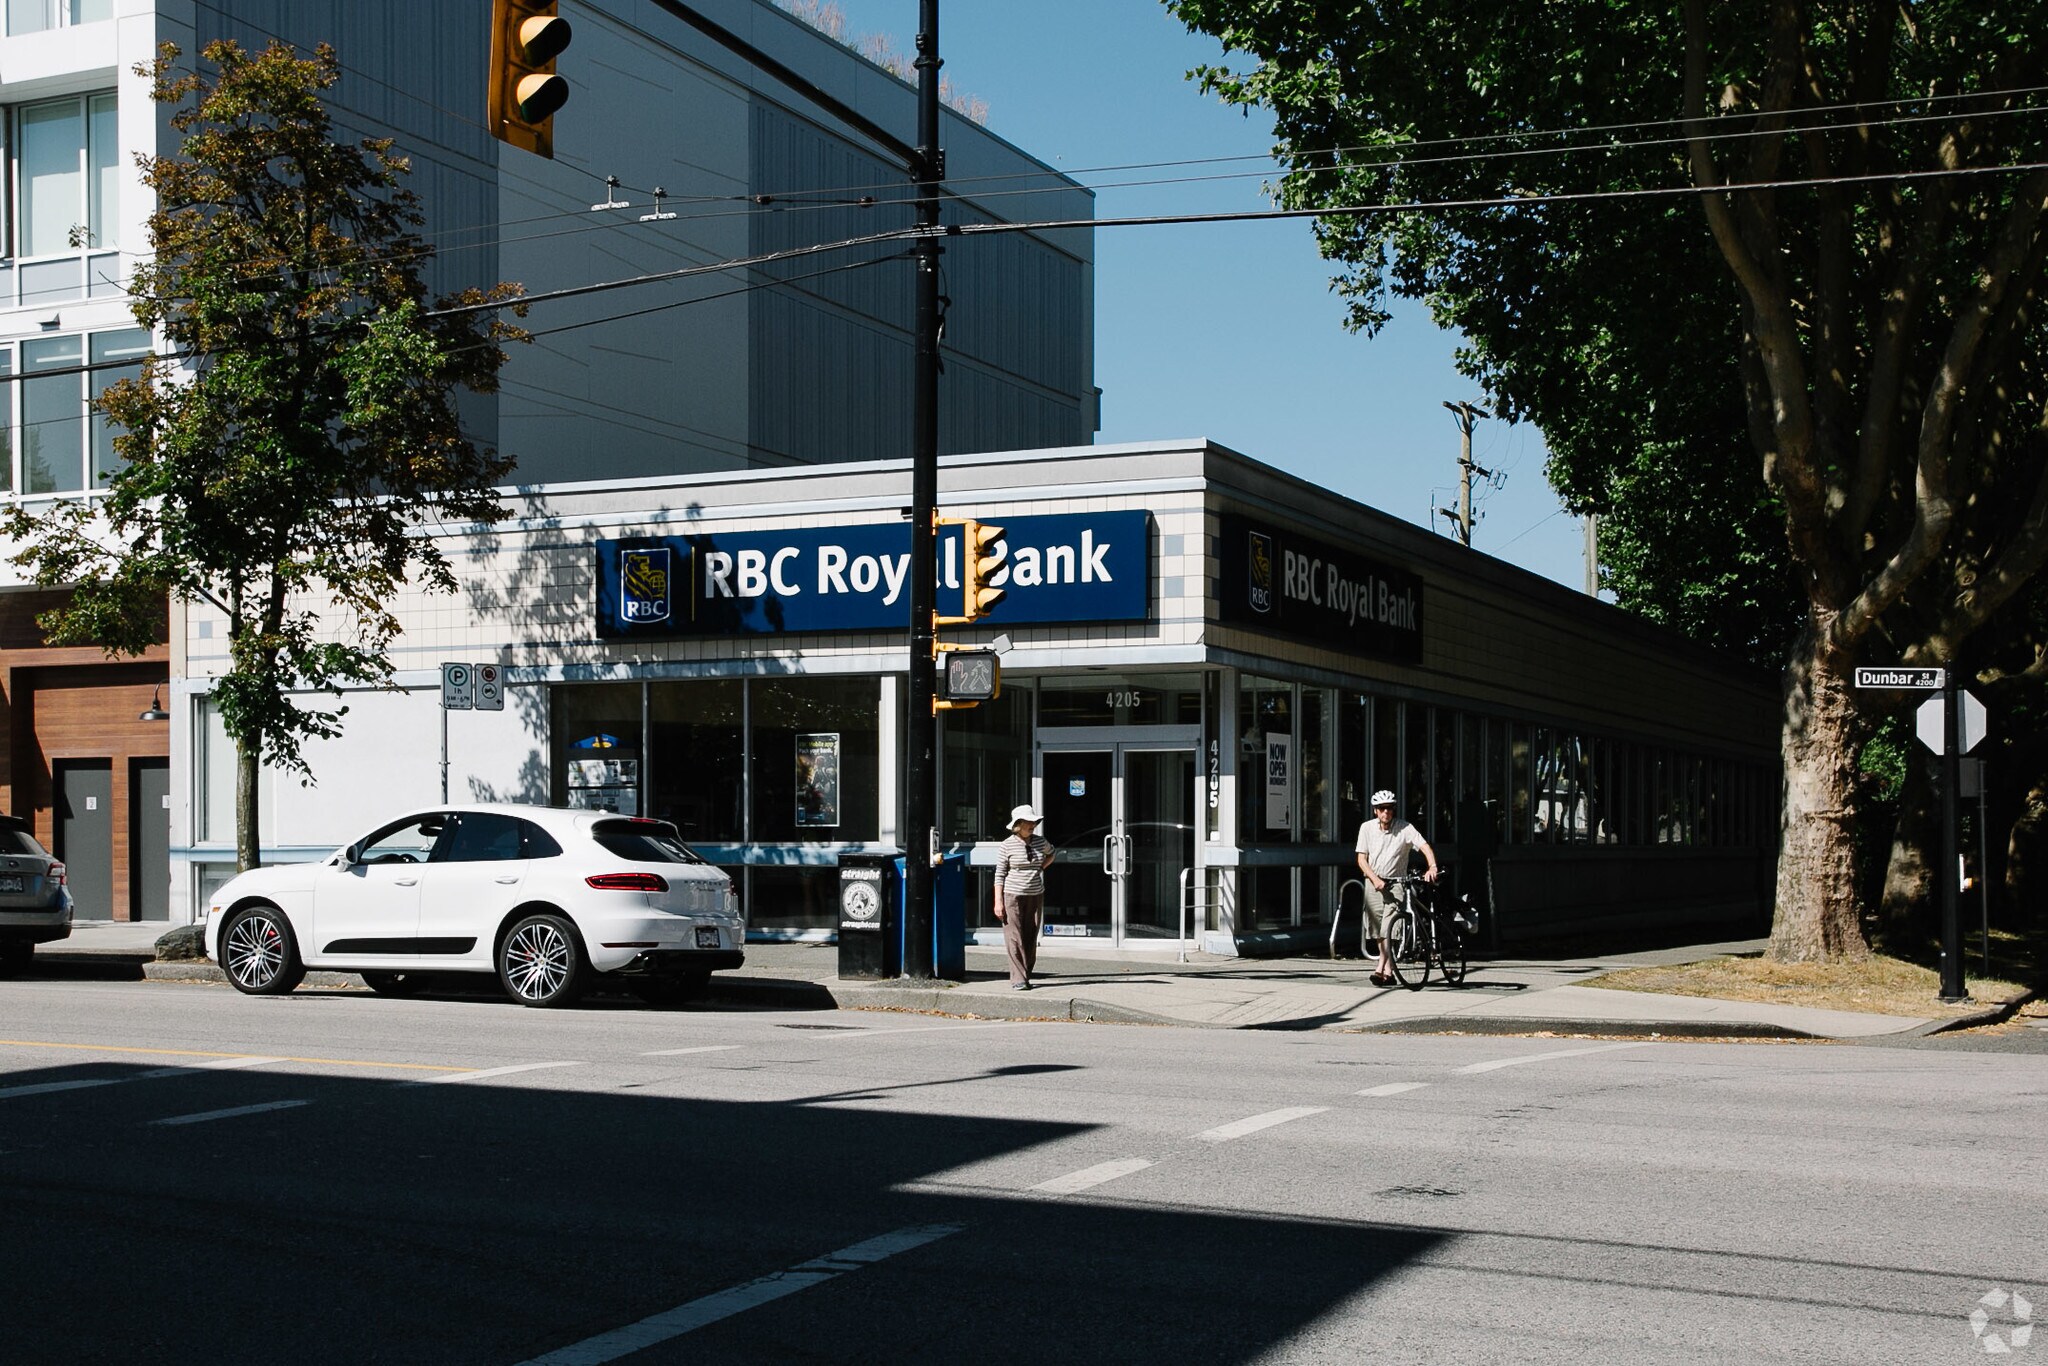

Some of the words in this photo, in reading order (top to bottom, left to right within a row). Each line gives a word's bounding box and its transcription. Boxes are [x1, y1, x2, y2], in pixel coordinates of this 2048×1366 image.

[705, 546, 801, 599] RBC
[818, 536, 960, 606] Royl
[1252, 587, 1269, 606] RBC
[1284, 550, 1322, 605] RBC
[1327, 563, 1374, 627] Royal
[1378, 580, 1416, 631] Bank
[627, 600, 664, 617] RBC
[454, 670, 463, 682] P
[1862, 672, 1913, 684] Dunbar
[1106, 691, 1141, 708] 4205
[1269, 743, 1286, 761] NOW
[1209, 739, 1219, 808] 4205
[1269, 761, 1286, 777] OPEN
[841, 869, 881, 880] straight
